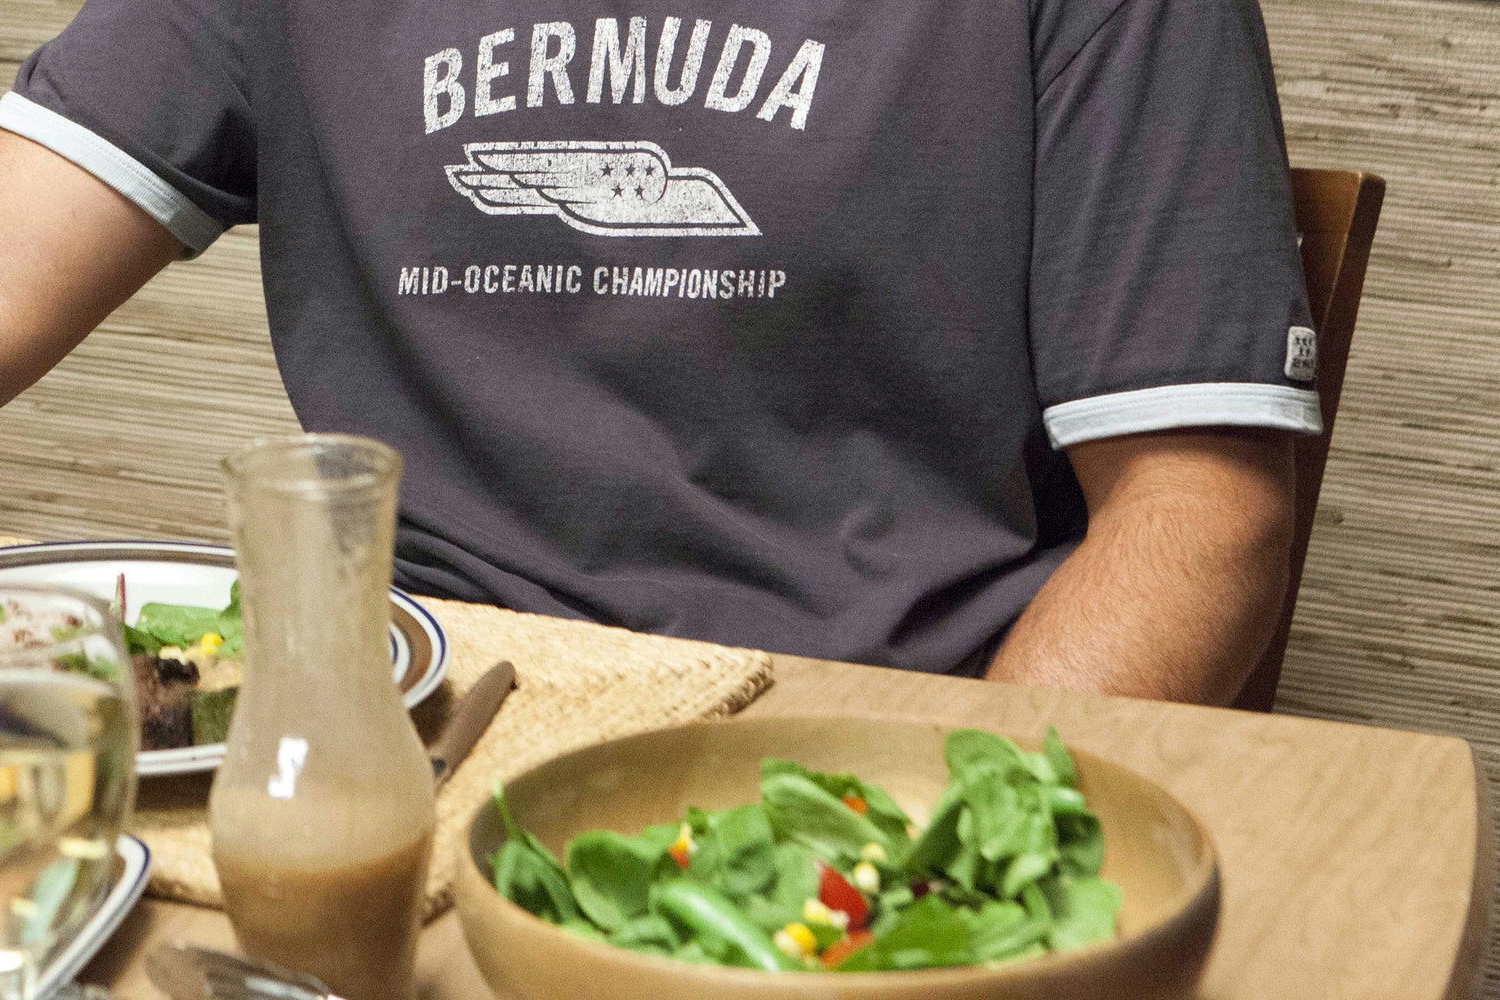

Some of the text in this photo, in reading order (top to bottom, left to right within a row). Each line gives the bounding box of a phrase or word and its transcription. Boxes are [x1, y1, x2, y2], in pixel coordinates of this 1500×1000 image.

[423, 16, 827, 136] BERMUDA
[398, 264, 787, 300] MID-OCEANIC CHAMPIONSHIP
